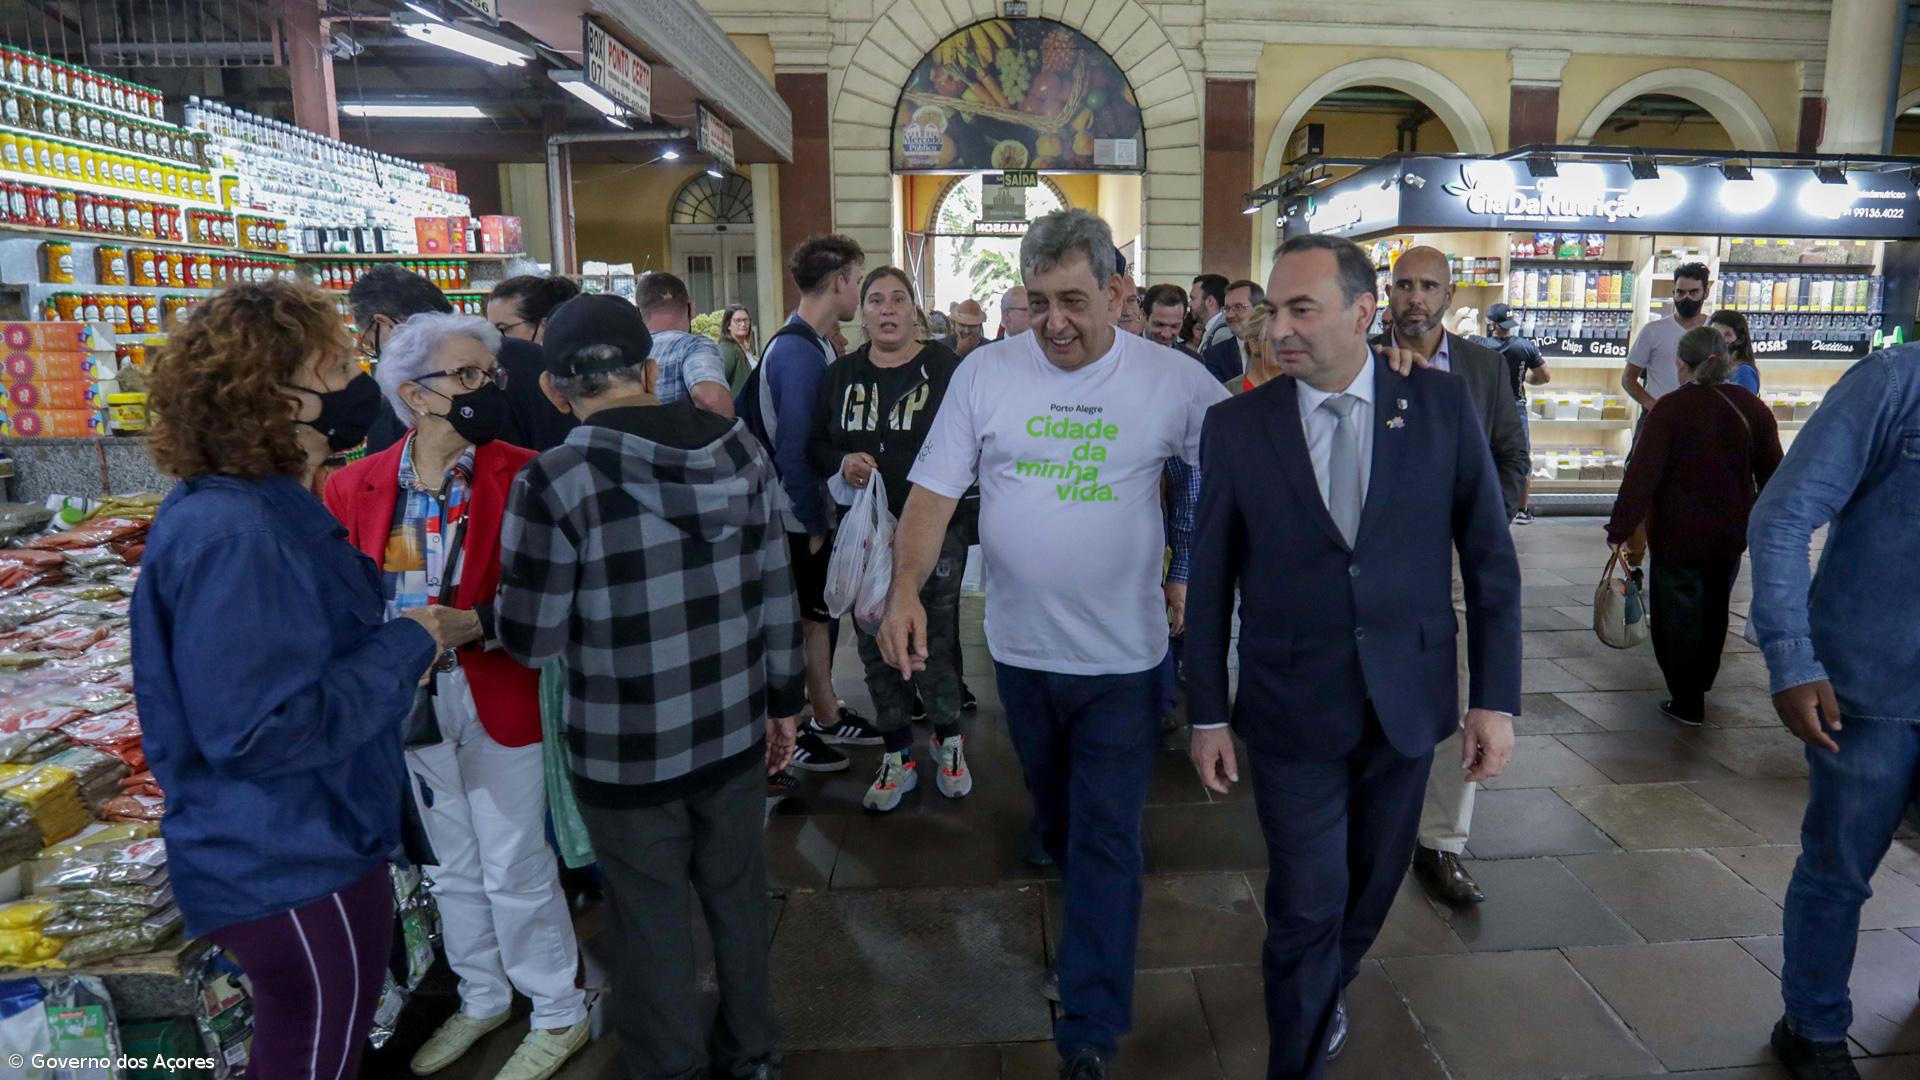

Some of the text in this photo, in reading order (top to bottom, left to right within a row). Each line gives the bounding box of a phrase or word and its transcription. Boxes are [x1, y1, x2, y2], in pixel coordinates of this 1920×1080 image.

[589, 27, 603, 59] BOX
[591, 60, 602, 84] 07
[608, 40, 629, 78] PONTO
[632, 58, 650, 92] CERTO
[903, 135, 943, 145] Mercado
[1005, 171, 1036, 186] SAÍDA
[1853, 207, 1904, 218] 99136.4022
[1561, 339, 1583, 355] Chips
[1590, 341, 1626, 356] Grãos
[1811, 340, 1854, 352] Dietéticos
[841, 382, 930, 431] GAP
[1050, 403, 1103, 415] Porto Alegre
[1026, 415, 1119, 440] Cidade
[1071, 441, 1107, 462] da
[1015, 458, 1099, 482] minha
[1056, 480, 1119, 502] vida.
